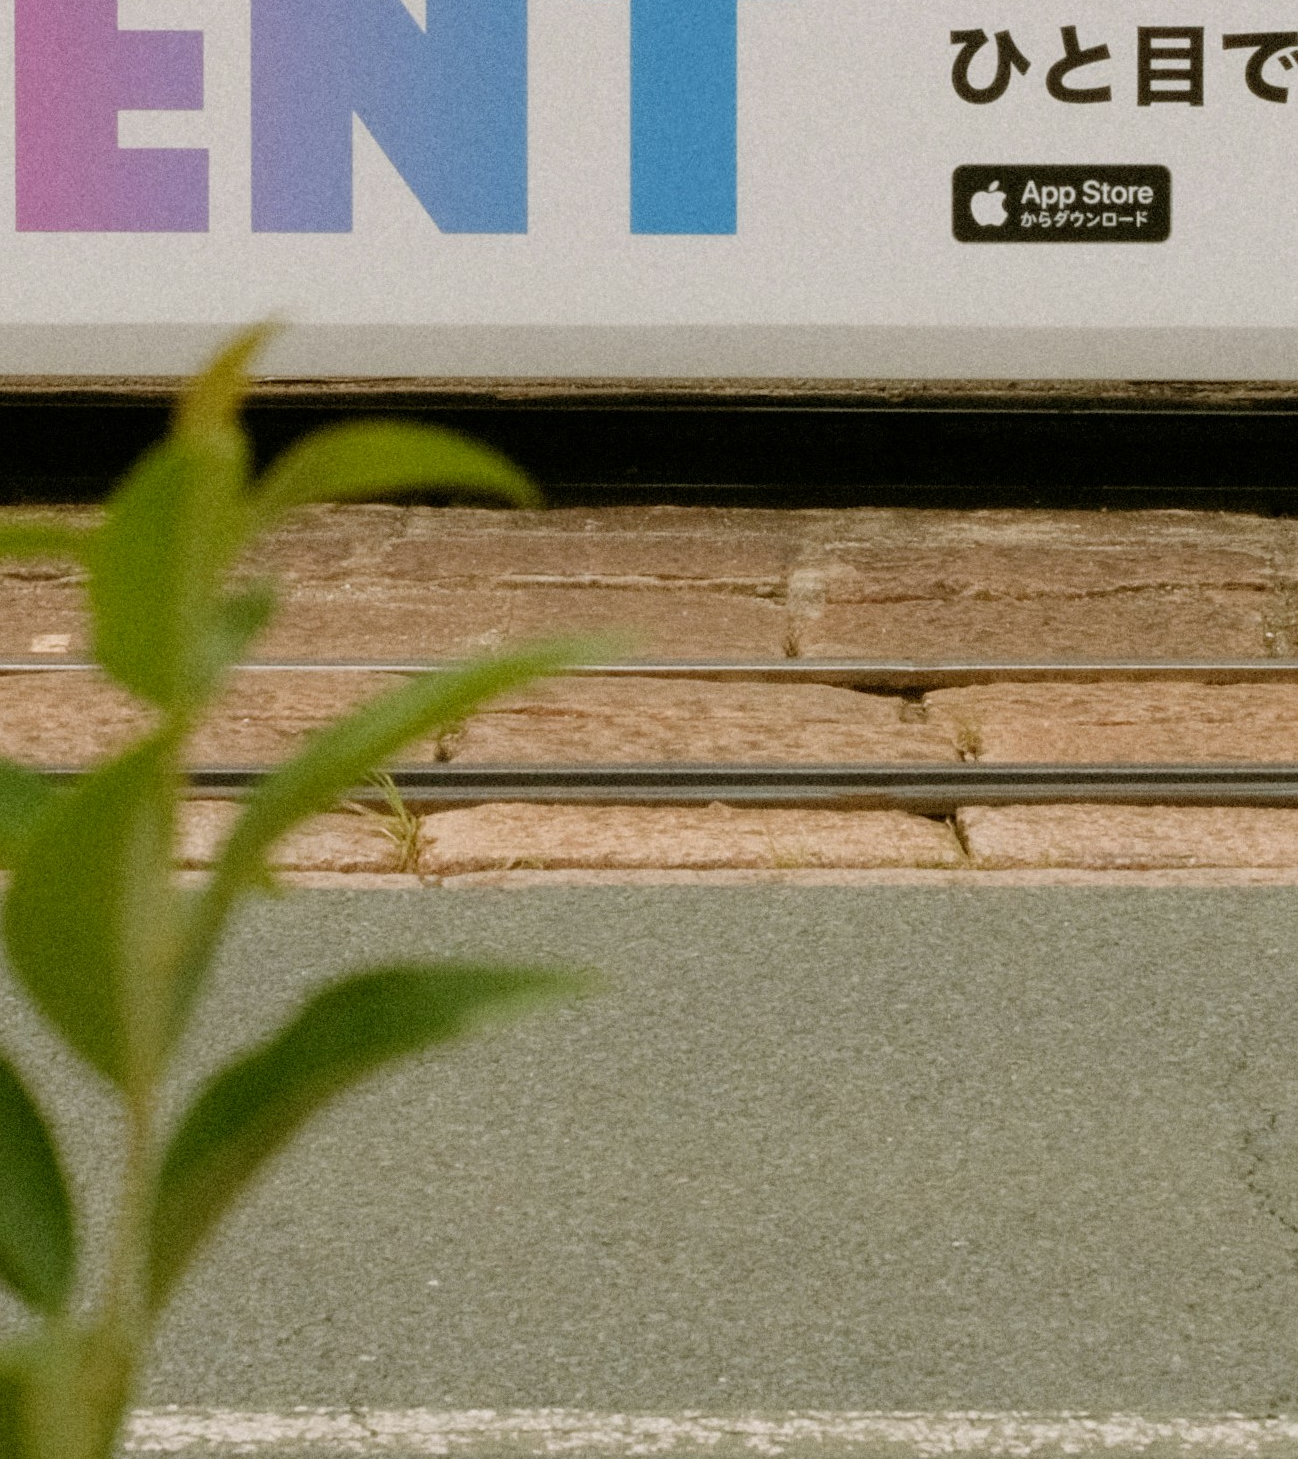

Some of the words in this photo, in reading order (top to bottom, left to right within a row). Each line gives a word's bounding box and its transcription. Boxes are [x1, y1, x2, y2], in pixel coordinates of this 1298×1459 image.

[1021, 180, 1077, 210] App
[1082, 180, 1154, 206] Store
[1020, 210, 1149, 228] からダウンロード
